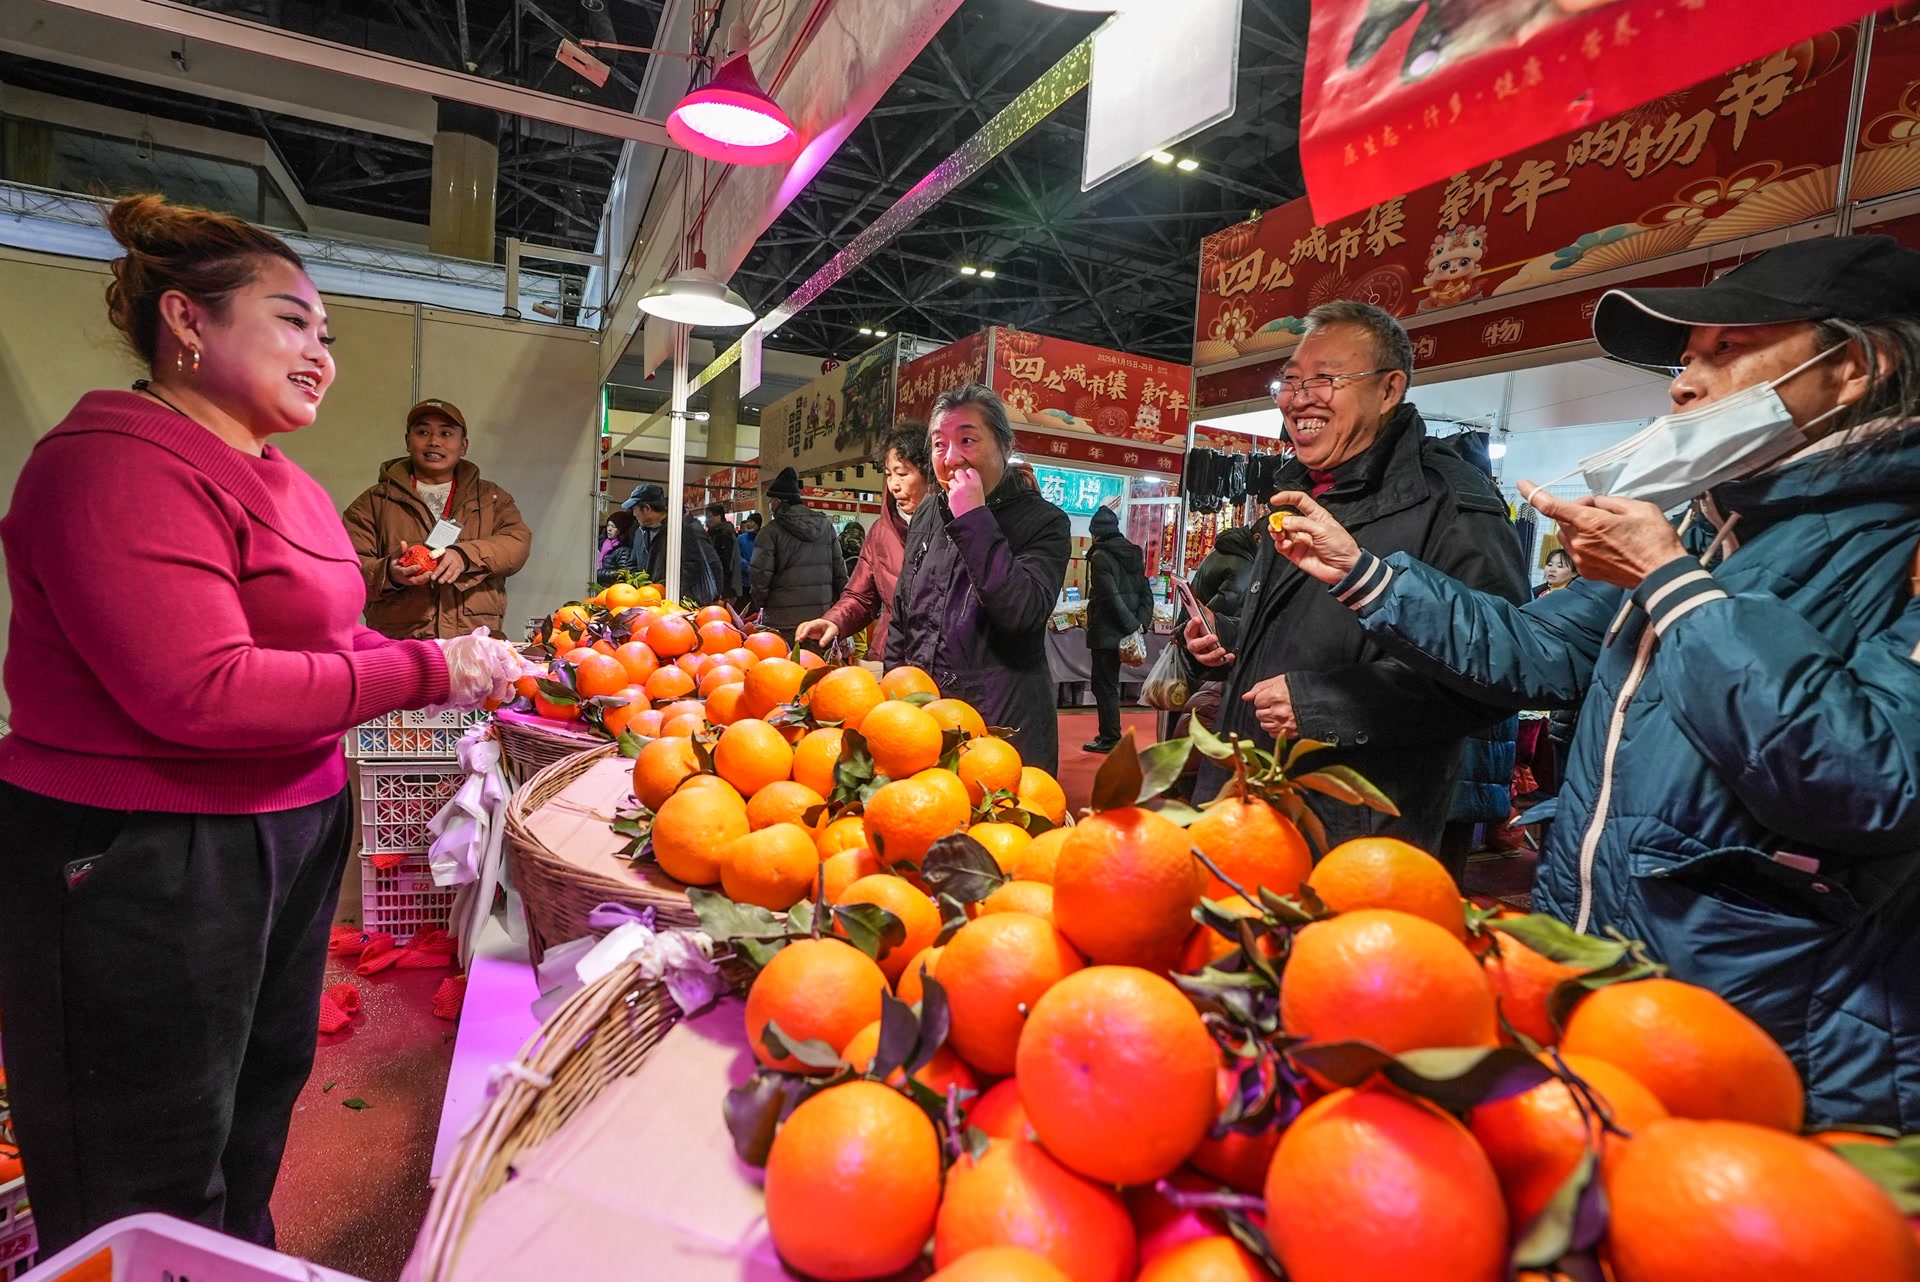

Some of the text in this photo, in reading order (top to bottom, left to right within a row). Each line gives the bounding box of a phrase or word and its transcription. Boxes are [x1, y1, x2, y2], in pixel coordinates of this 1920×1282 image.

[1217, 53, 1798, 297] 四九城市集 新年购物节
[1097, 354, 1153, 372] 2025年1月15日-25日
[1009, 356, 1192, 422] 四九城市集 新年
[1050, 440, 1173, 469] 新年购物
